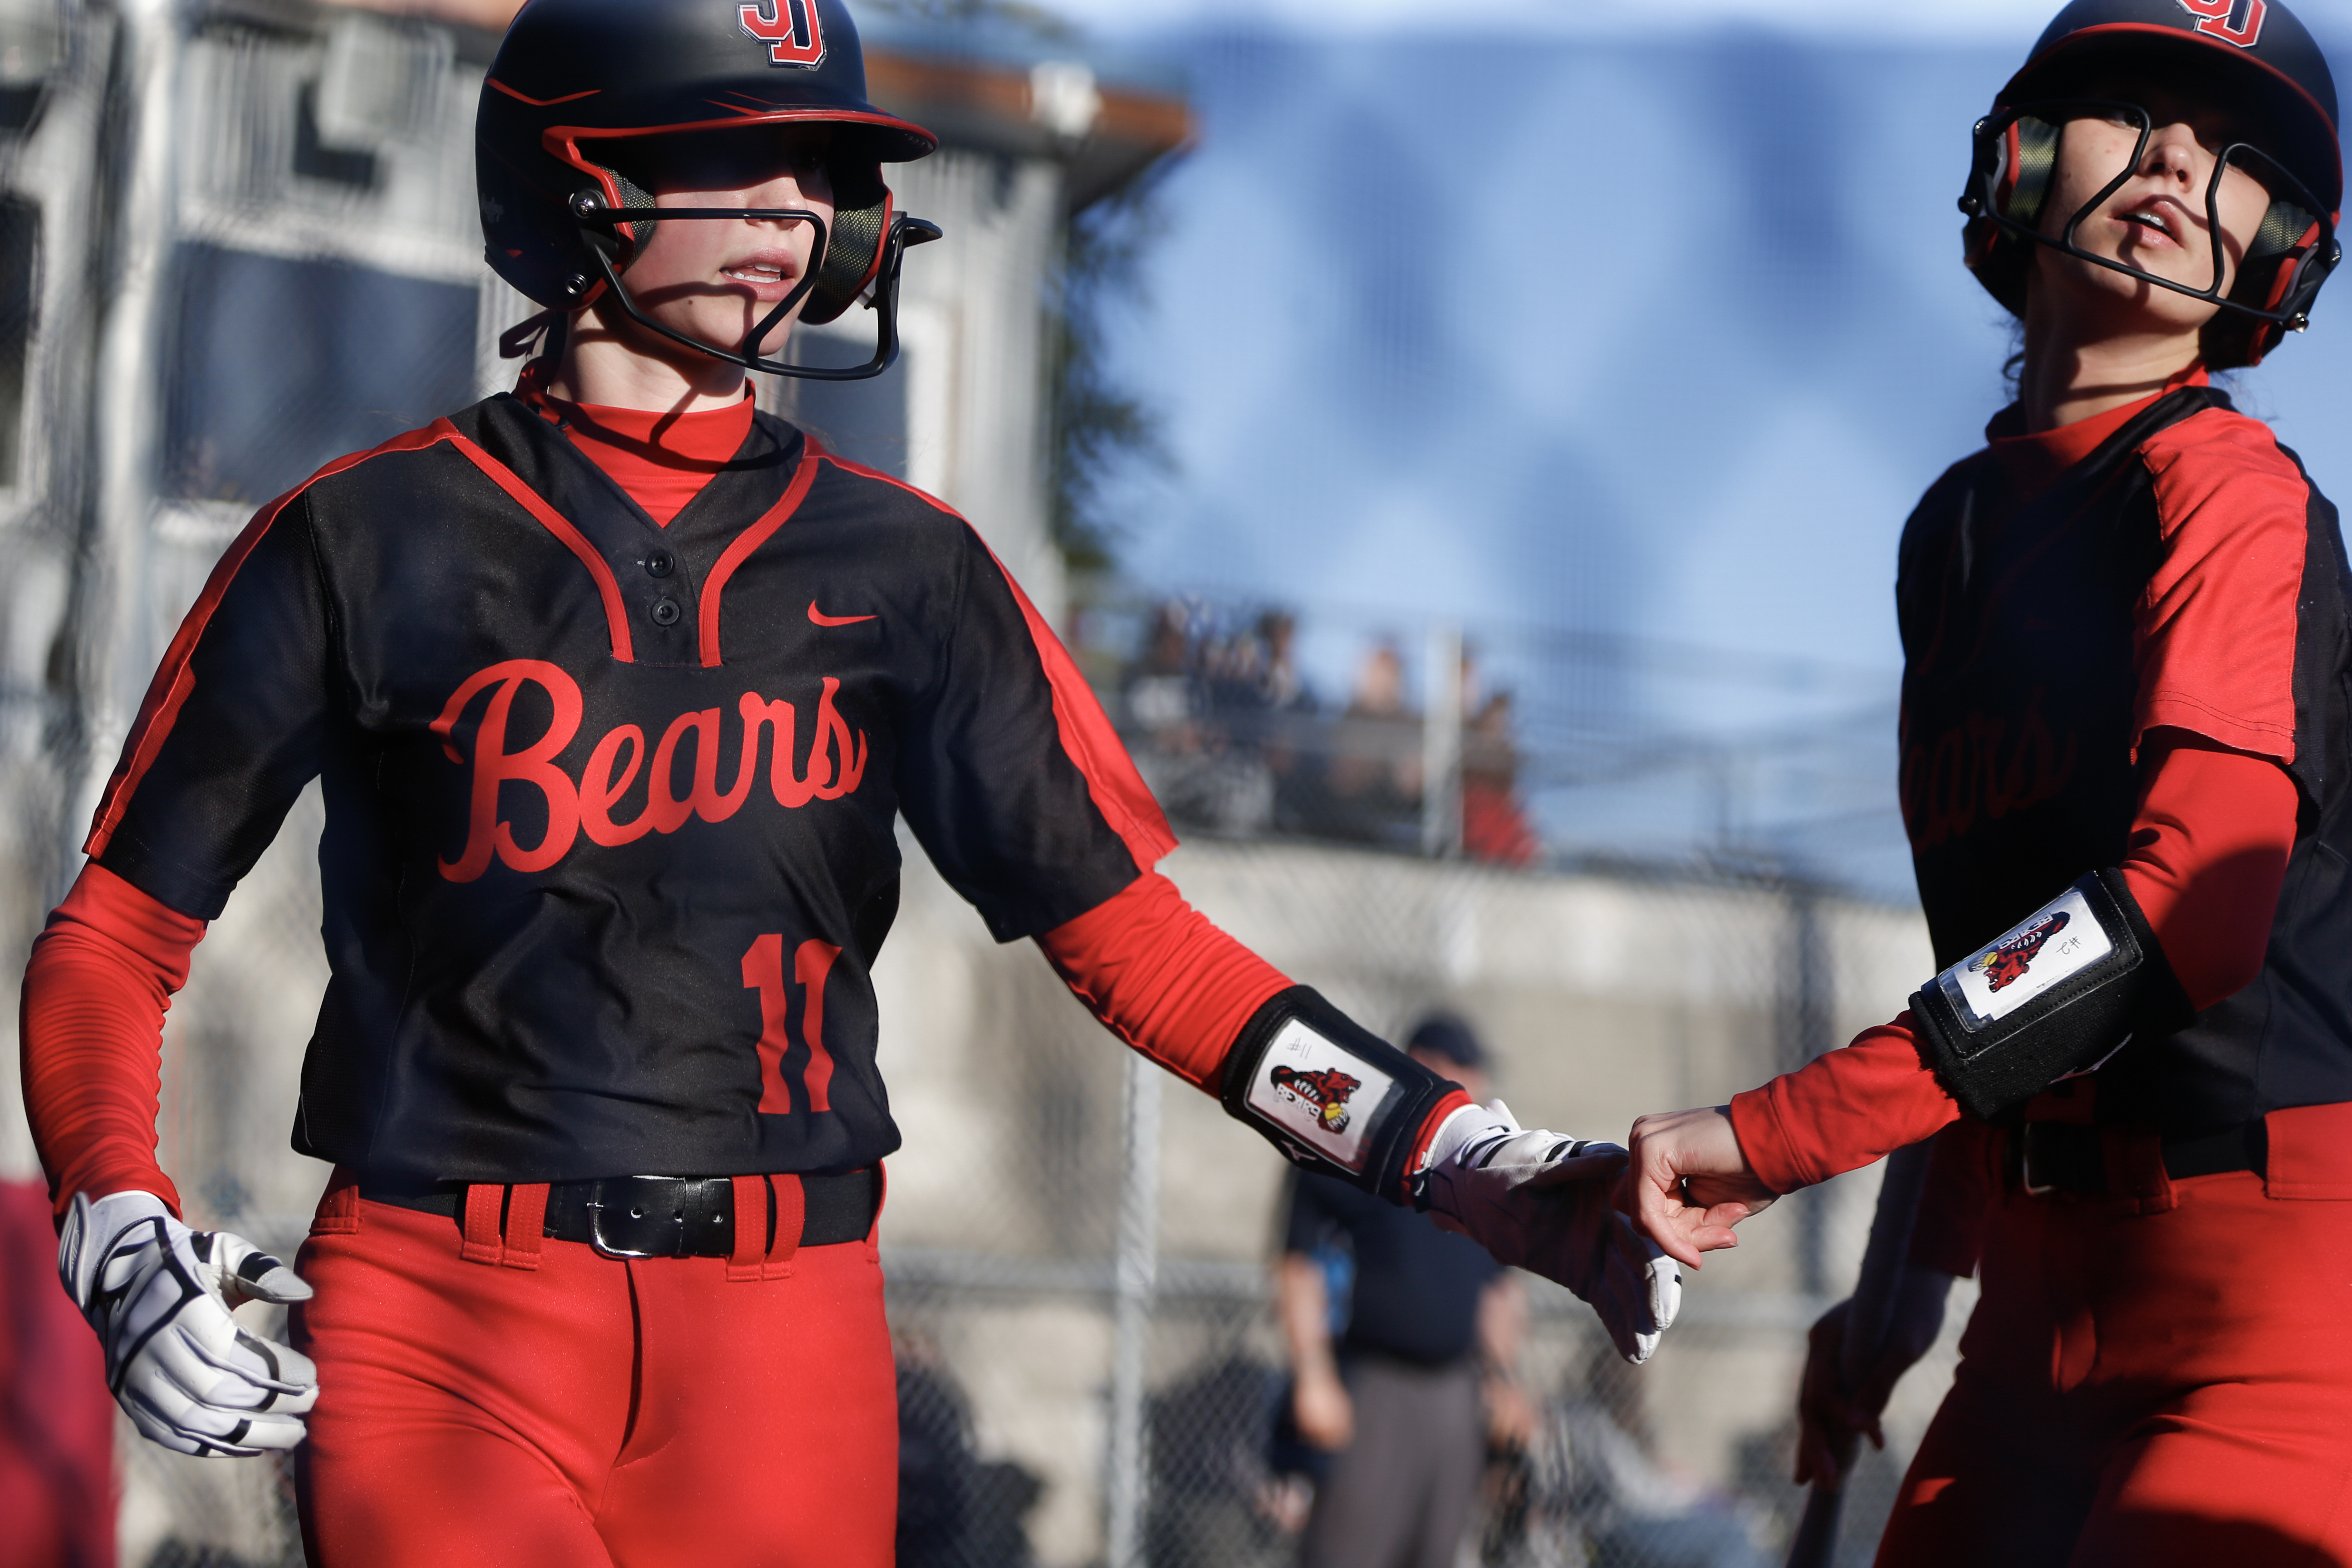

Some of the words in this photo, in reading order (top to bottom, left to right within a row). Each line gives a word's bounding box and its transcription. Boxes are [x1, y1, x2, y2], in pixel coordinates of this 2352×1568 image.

[2176, 0, 2267, 48] D
[429, 659, 867, 883] Bears
[1900, 683, 2078, 859] ears
[2056, 936, 2082, 955] #2
[740, 933, 843, 1114] 11
[1287, 1036, 1312, 1060] #11
